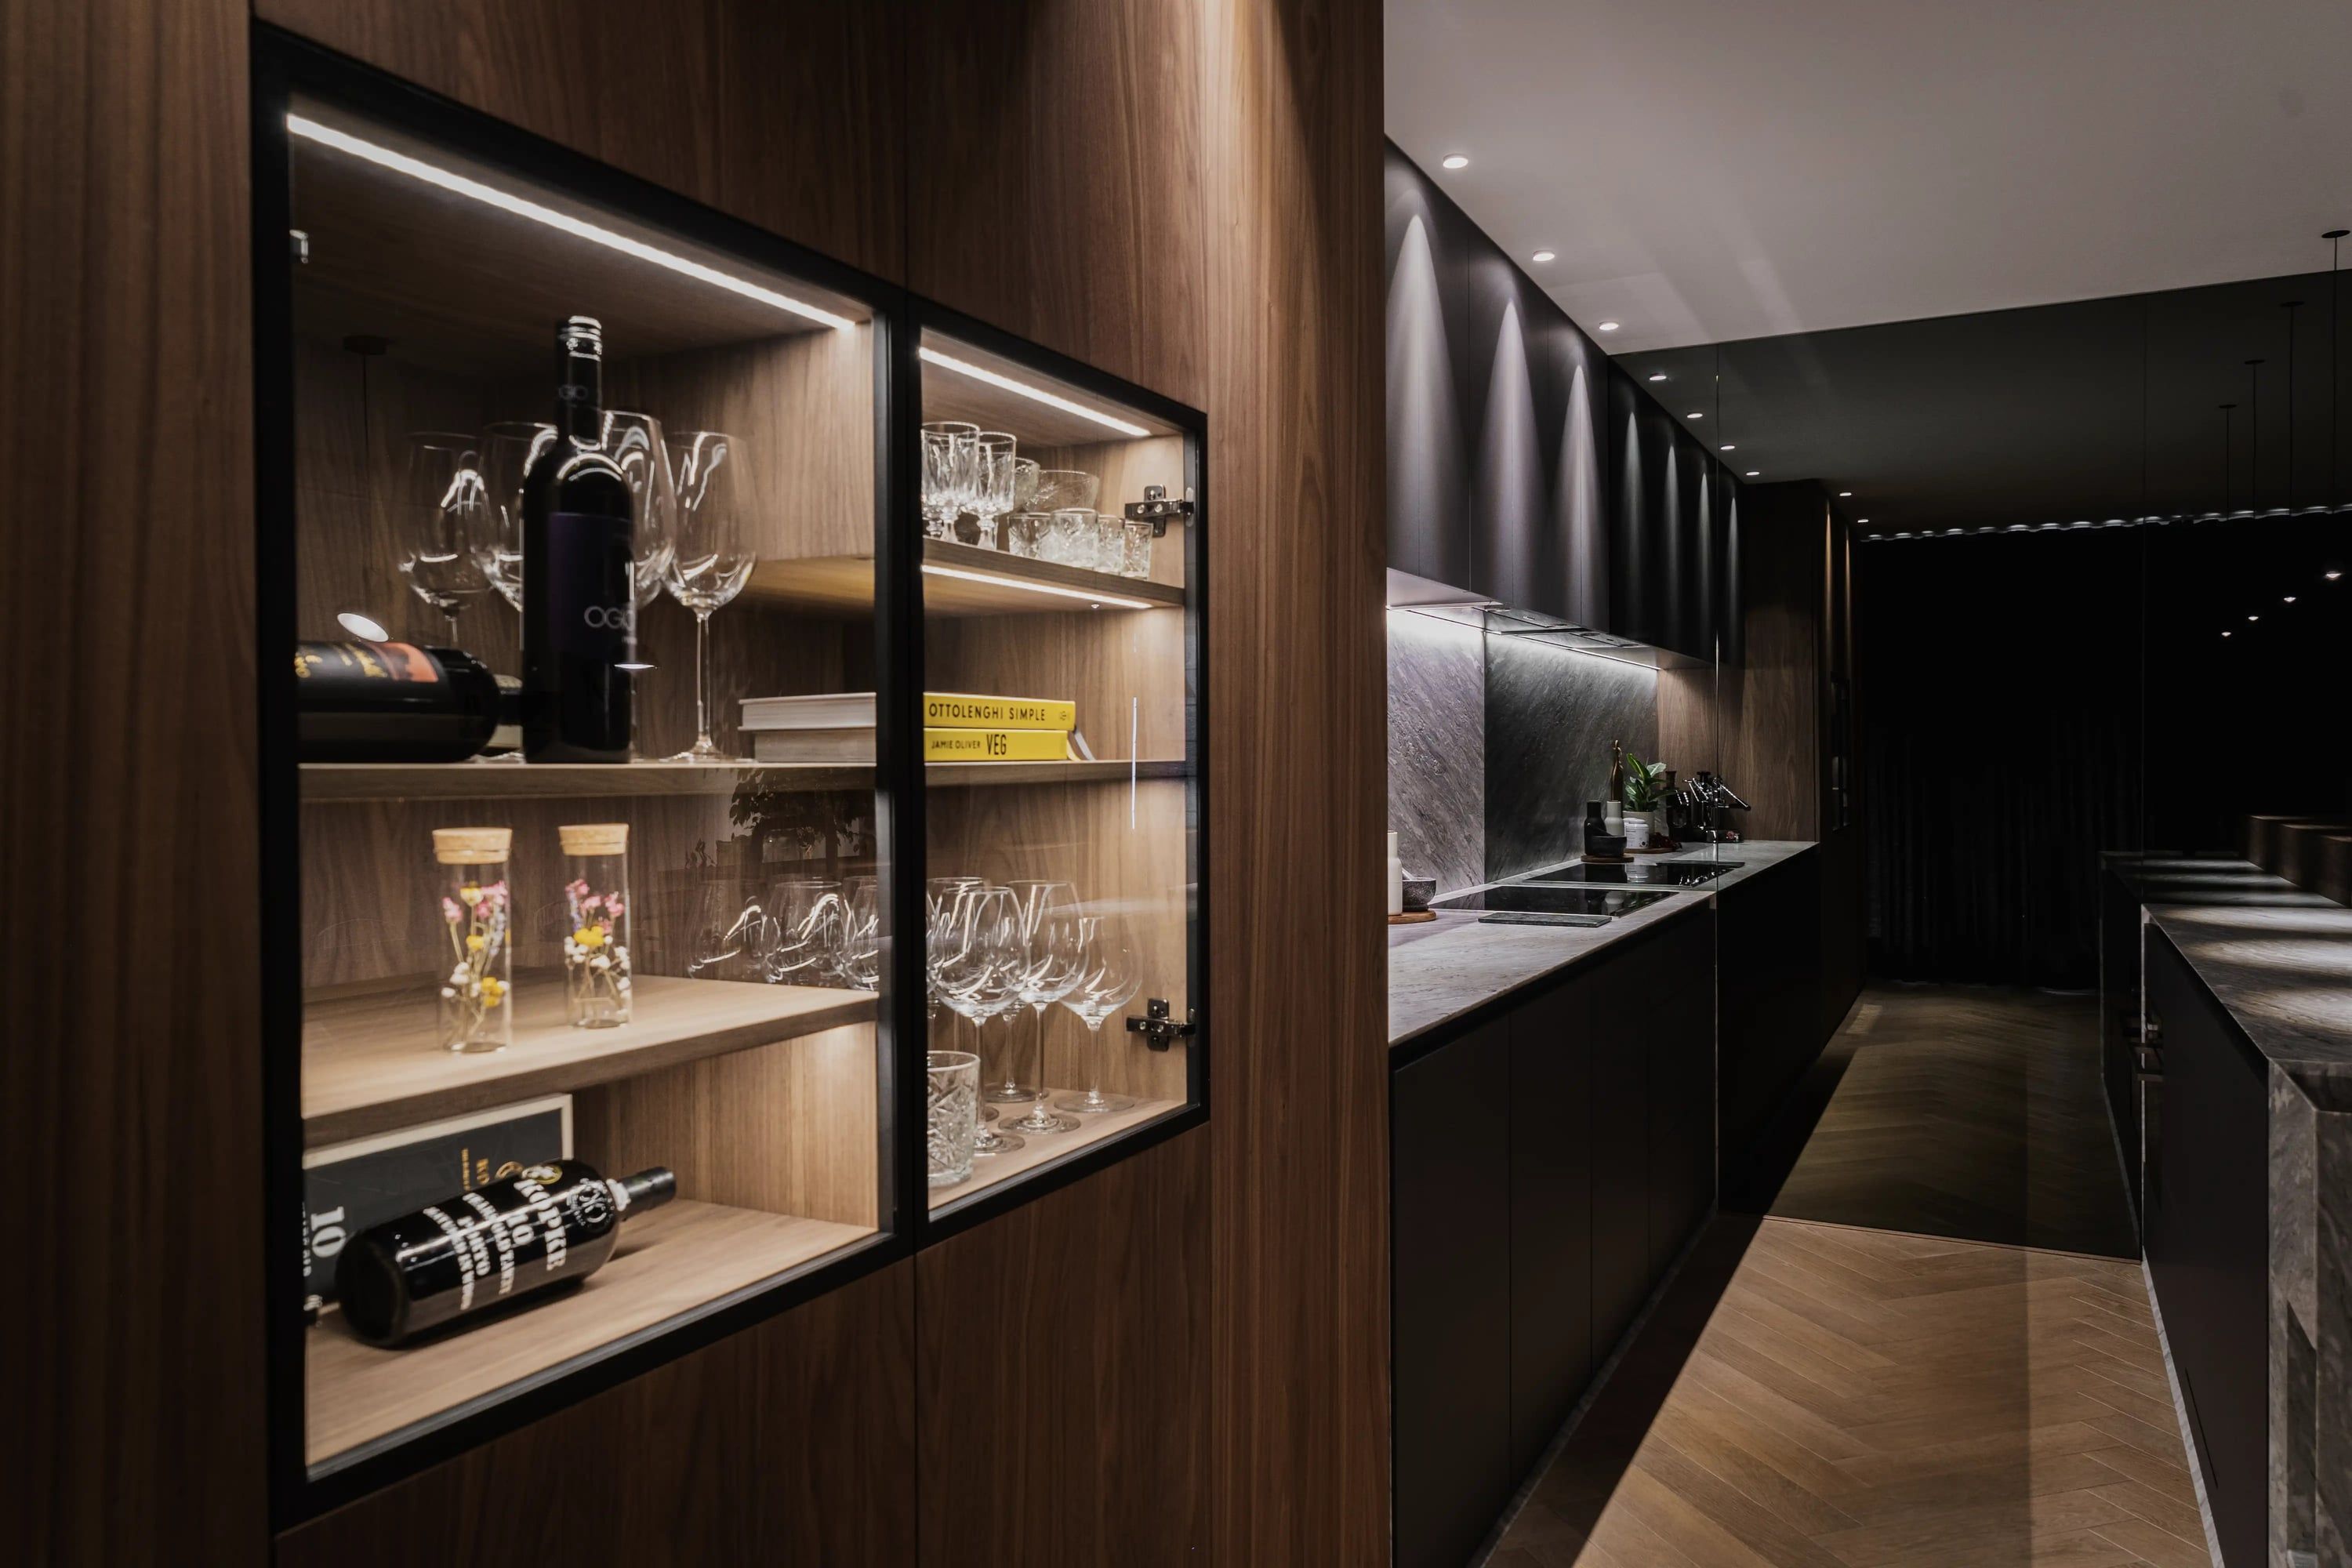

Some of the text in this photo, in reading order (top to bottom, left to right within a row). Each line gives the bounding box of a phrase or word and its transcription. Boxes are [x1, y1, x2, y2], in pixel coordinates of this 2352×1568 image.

[928, 702, 1046, 721] OTTOLENGHI SIMPLE
[931, 740, 982, 750] JAMIE OLIVER
[986, 734, 1007, 756] VEG
[310, 1206, 347, 1258] 10
[506, 1212, 535, 1246] 10
[513, 1178, 567, 1272] KOPKE
